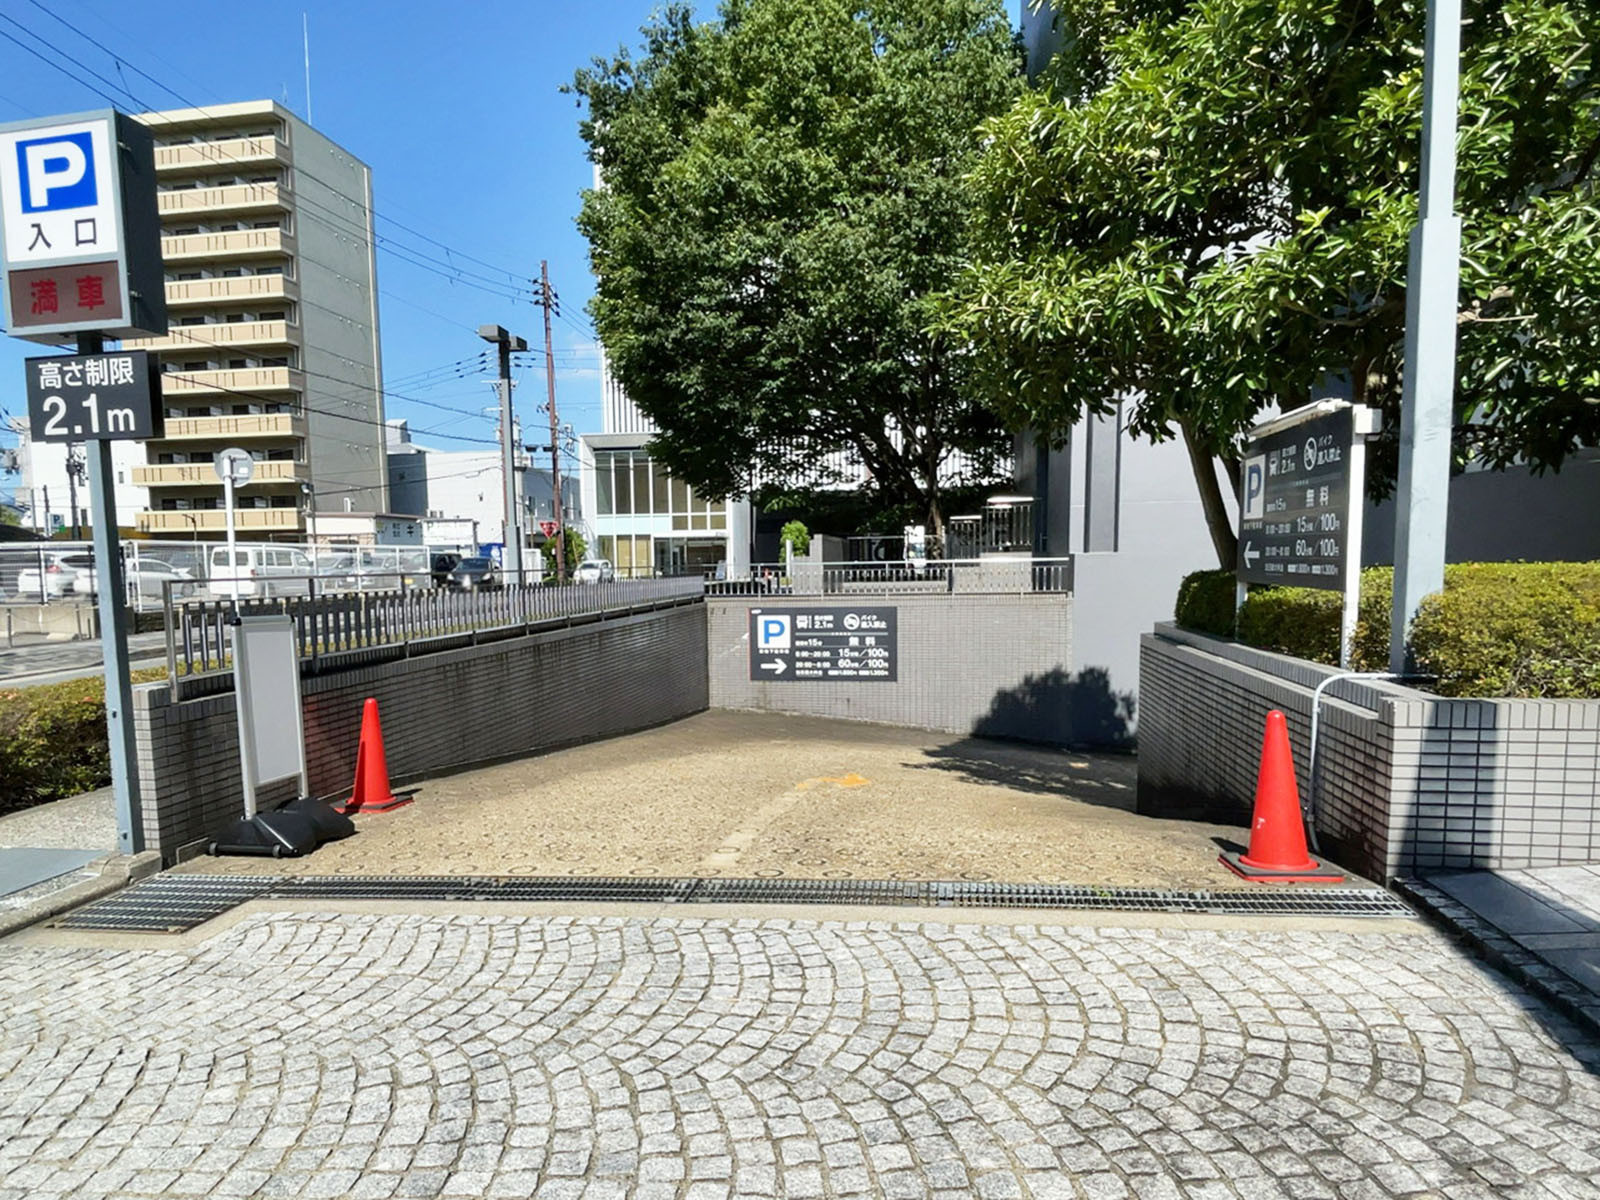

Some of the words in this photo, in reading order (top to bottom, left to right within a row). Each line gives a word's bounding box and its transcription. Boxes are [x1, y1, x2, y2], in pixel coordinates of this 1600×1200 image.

[25, 141, 87, 208] P
[28, 218, 98, 251] 入口
[30, 275, 106, 315] 満車
[38, 357, 135, 390] 高さ制限
[42, 393, 136, 436] 2.1m
[1247, 463, 1262, 513] P
[763, 619, 785, 644] P
[814, 620, 834, 629] 2.1m
[848, 636, 876, 647] 無料
